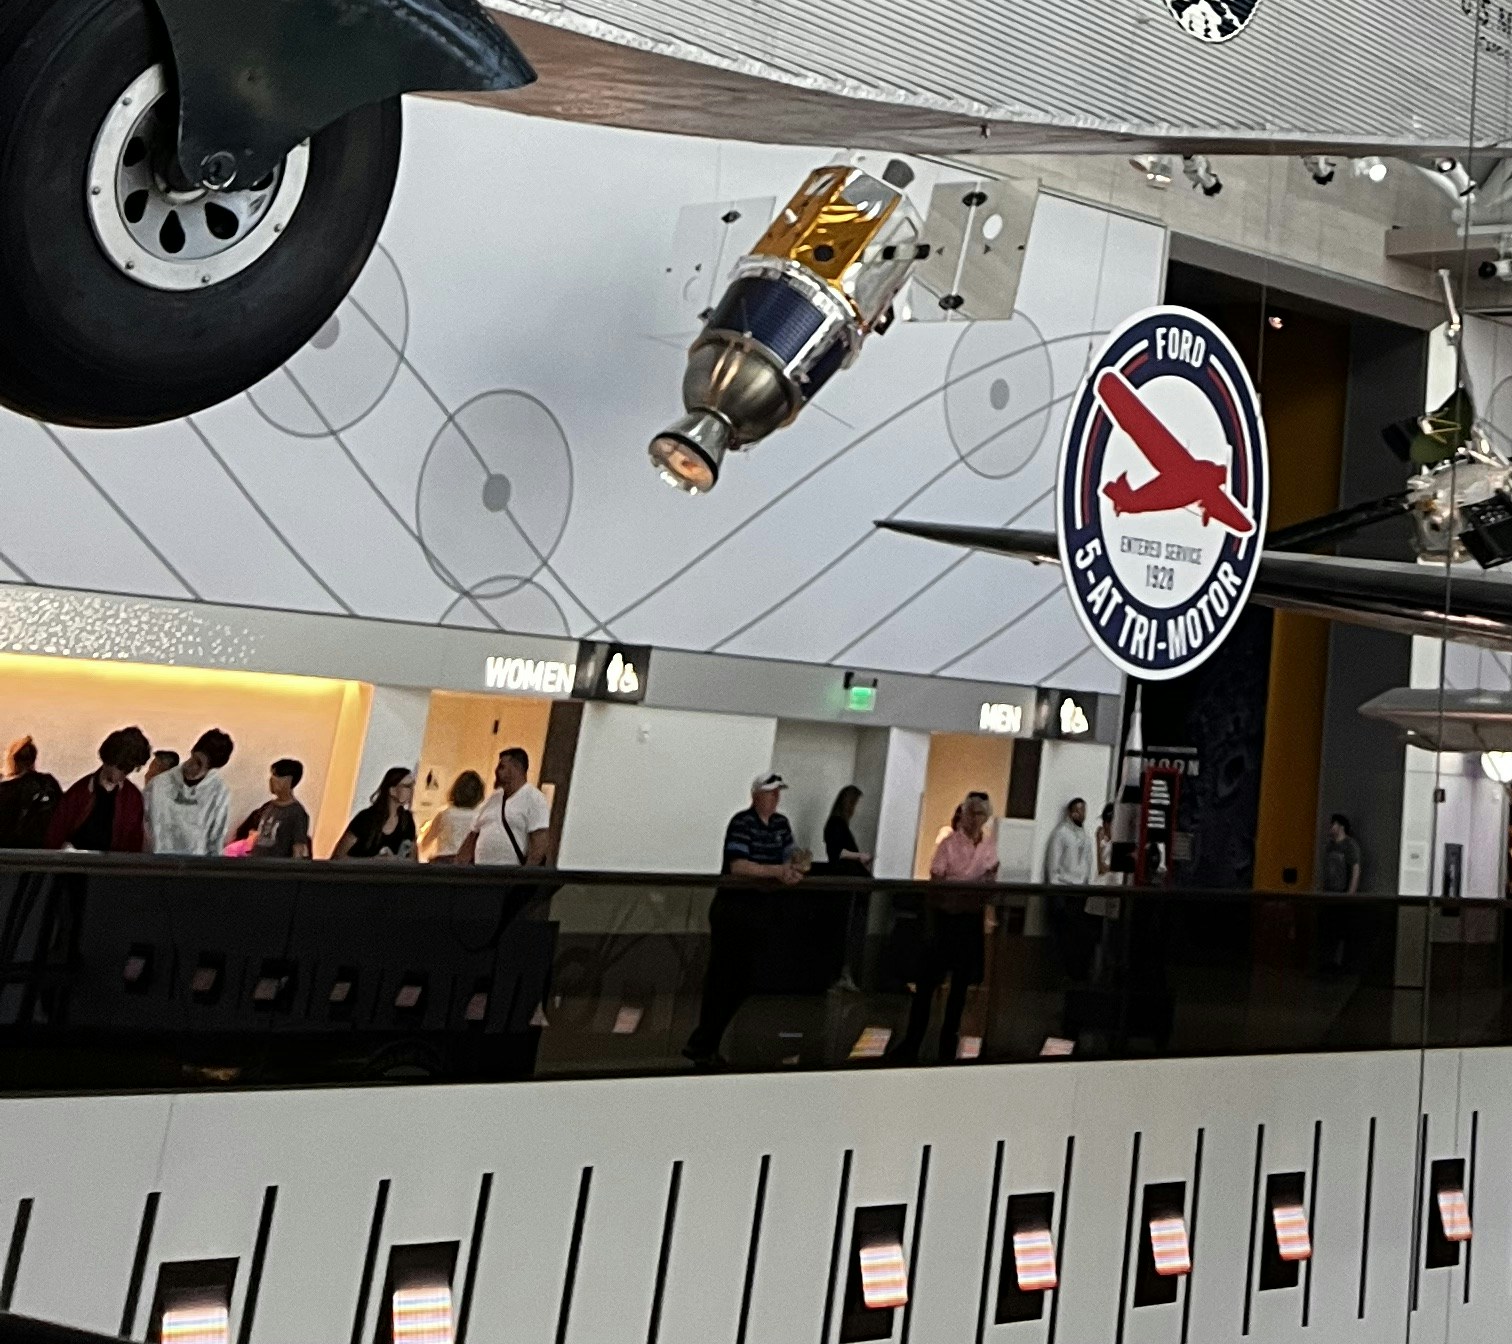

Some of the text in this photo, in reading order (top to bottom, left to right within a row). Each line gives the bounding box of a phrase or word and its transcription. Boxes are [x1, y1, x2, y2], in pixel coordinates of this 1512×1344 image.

[1156, 326, 1206, 368] FORD
[1120, 535, 1202, 565] ENTERED SERVICE
[1146, 564, 1175, 591] 1928
[1075, 538, 1243, 662] 5-AT TRI-MOTOR
[485, 656, 577, 693] WOMEN
[980, 702, 1022, 733] MEN
